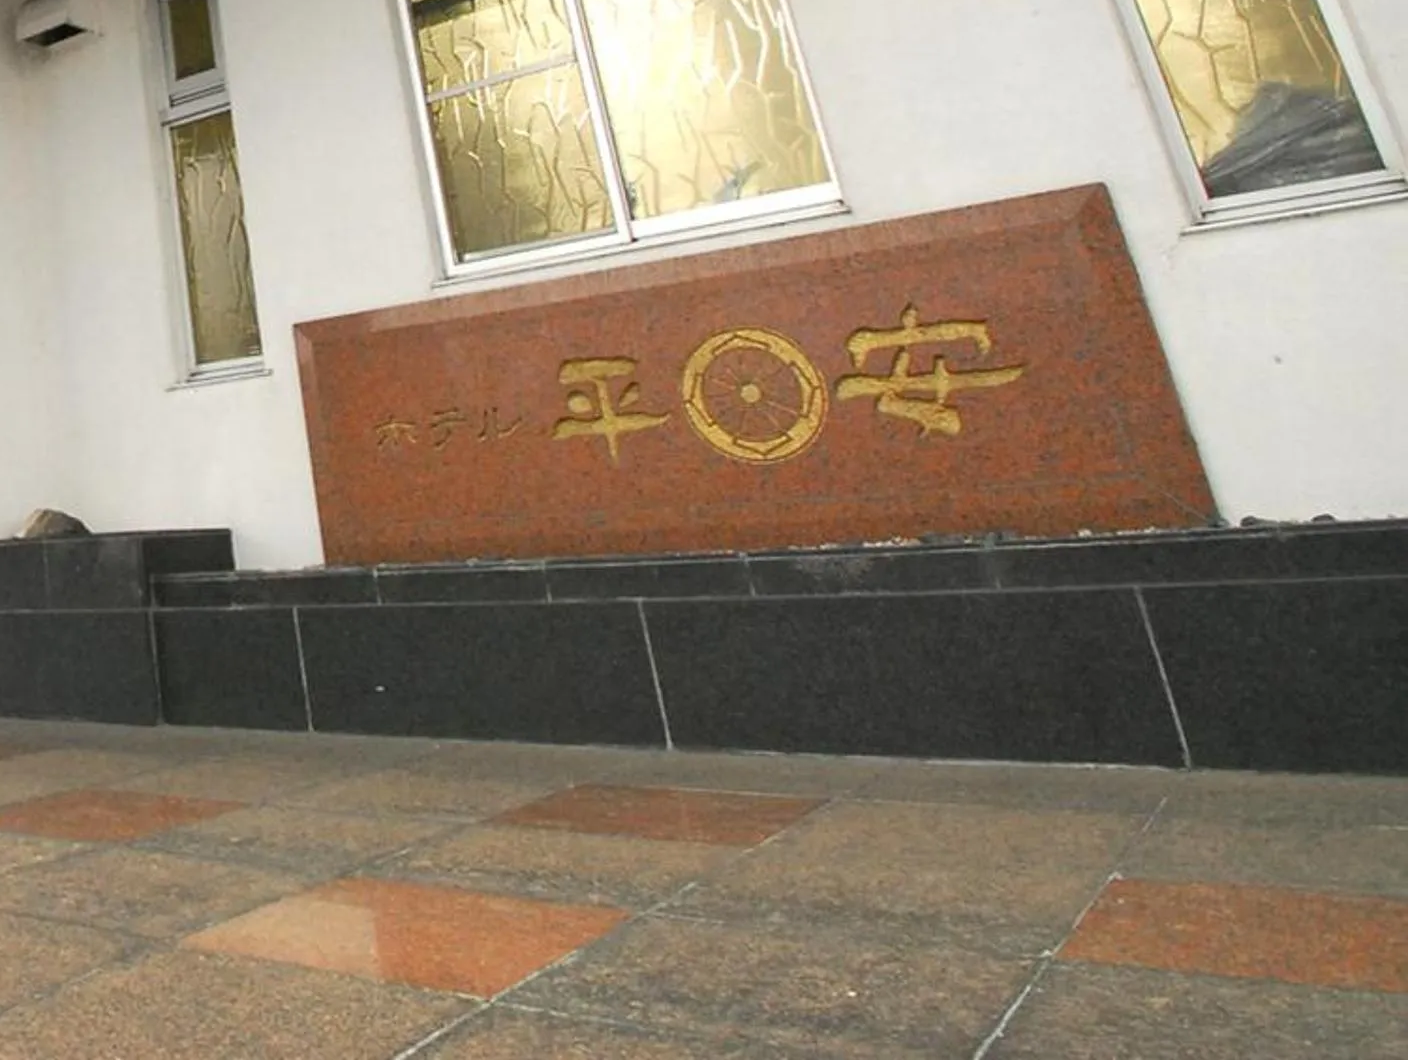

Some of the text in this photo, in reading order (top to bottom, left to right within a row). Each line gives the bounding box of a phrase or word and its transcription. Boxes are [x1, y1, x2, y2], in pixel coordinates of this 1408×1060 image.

[373, 302, 1029, 467] ホテル 平 安
